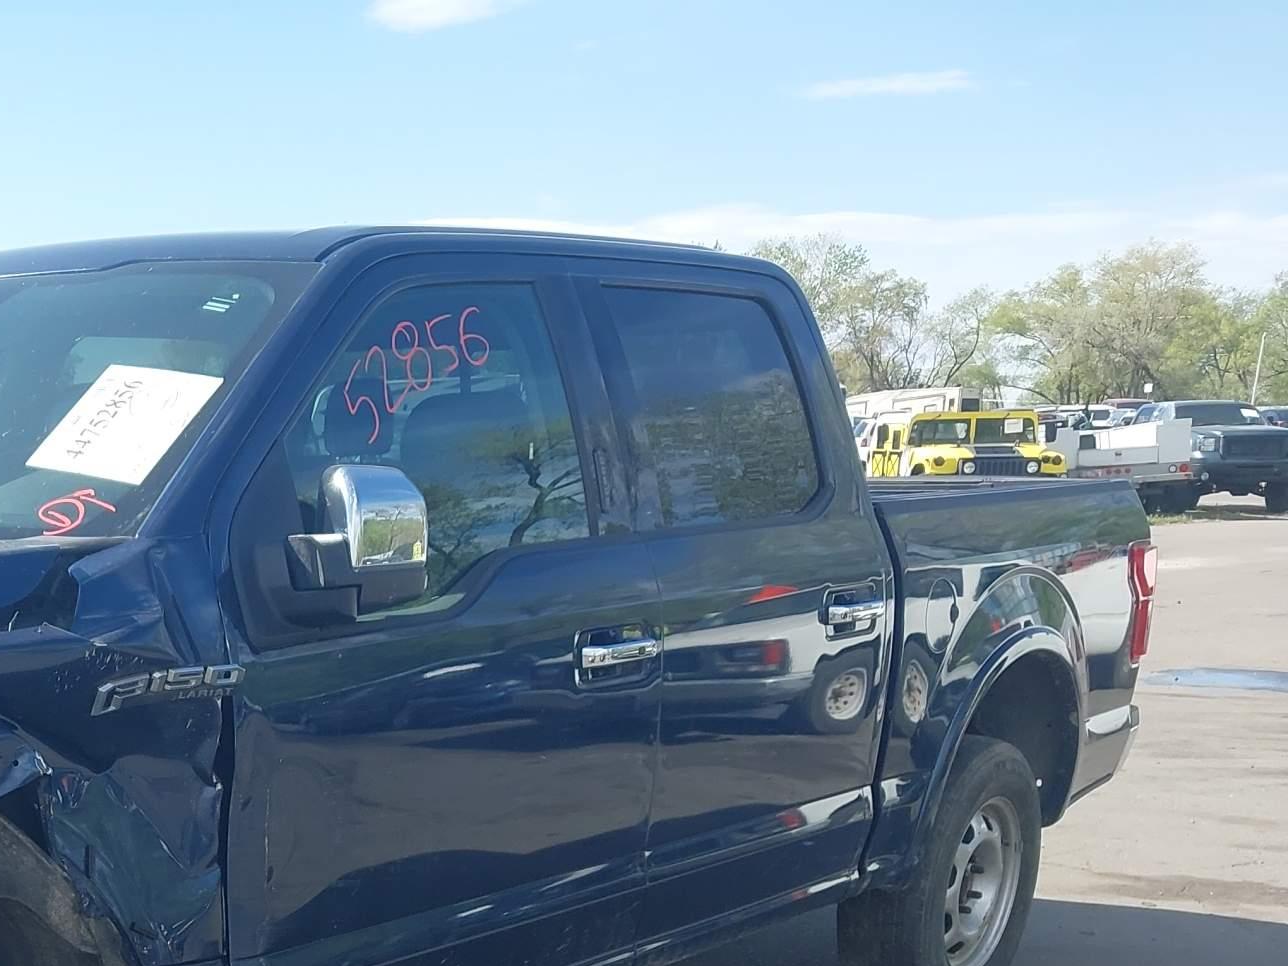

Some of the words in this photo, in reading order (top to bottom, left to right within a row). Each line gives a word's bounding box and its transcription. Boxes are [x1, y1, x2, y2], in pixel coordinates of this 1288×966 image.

[343, 306, 490, 444] 52856
[66, 379, 144, 460] 44752856
[178, 687, 234, 700] LARIAT
